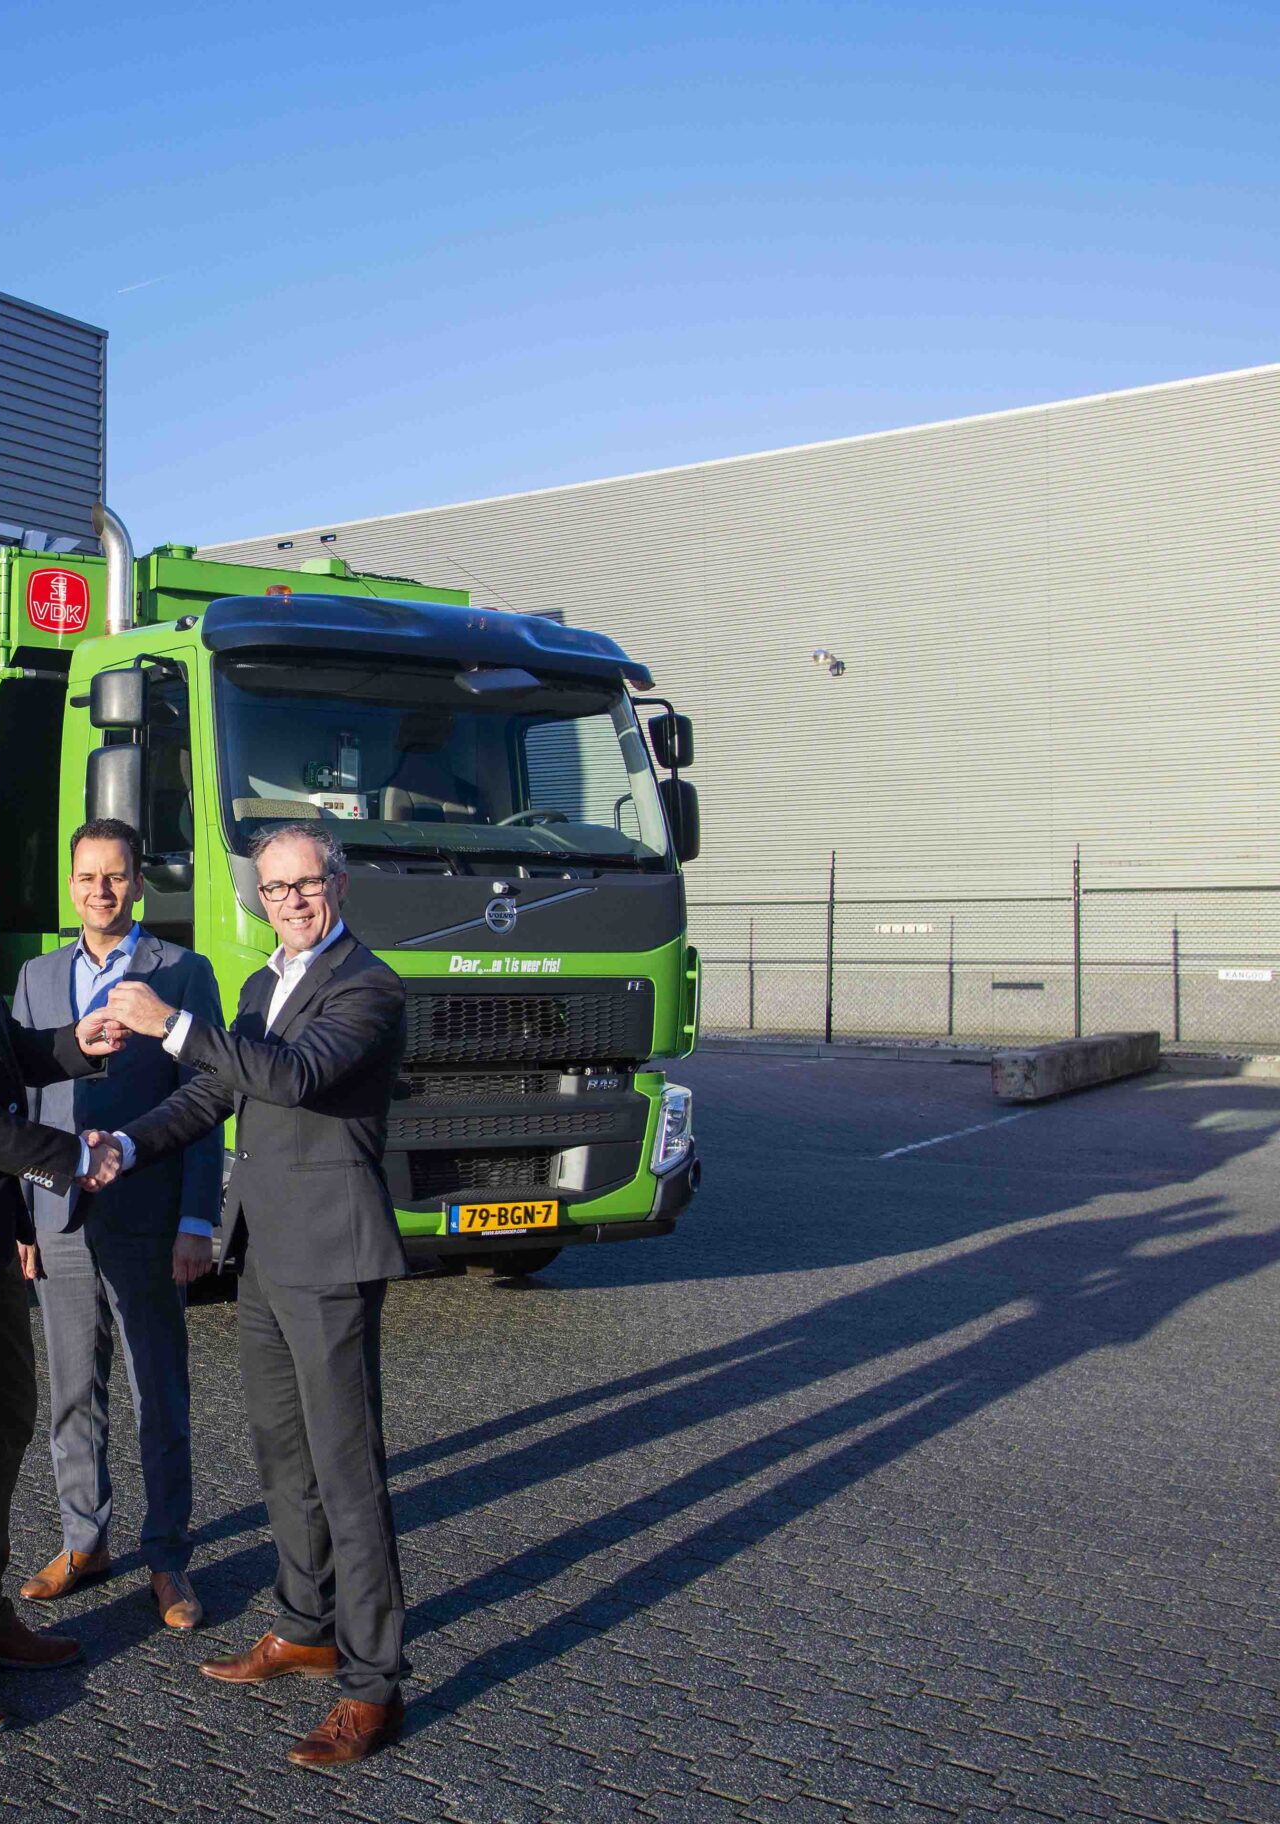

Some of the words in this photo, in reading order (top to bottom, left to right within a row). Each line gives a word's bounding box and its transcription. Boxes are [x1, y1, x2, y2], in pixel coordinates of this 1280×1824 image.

[33, 601, 82, 624] VDK
[521, 960, 541, 973] weer
[542, 958, 561, 973] fris!
[627, 980, 645, 991] FE
[466, 1204, 553, 1228] 79-BGN-7
